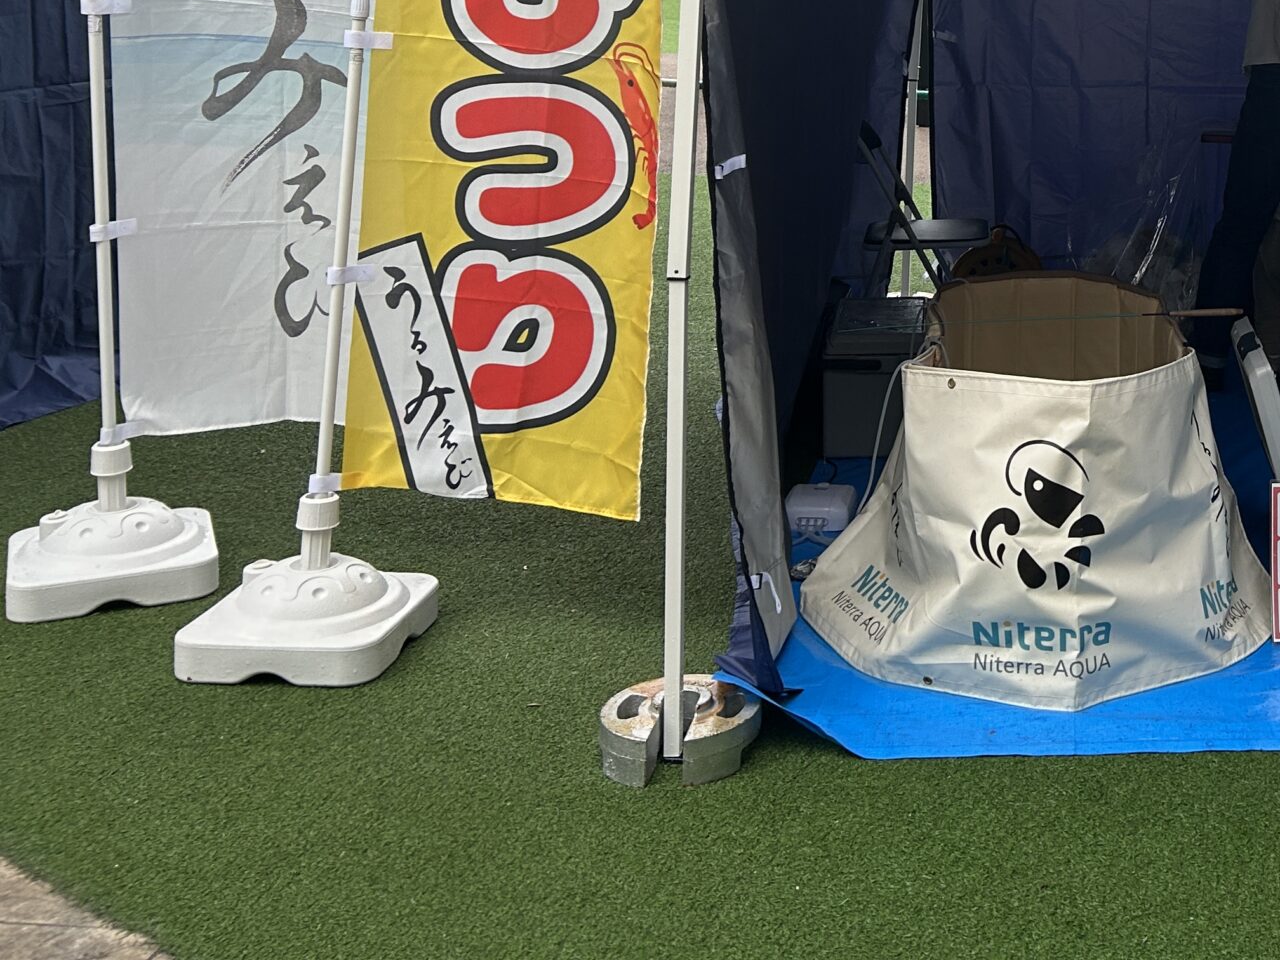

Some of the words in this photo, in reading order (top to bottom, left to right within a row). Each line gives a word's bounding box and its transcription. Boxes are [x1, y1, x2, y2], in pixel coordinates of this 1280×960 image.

[972, 620, 1112, 653] Niterra
[973, 653, 1045, 677] Niterra
[1053, 653, 1111, 680] AQUA
